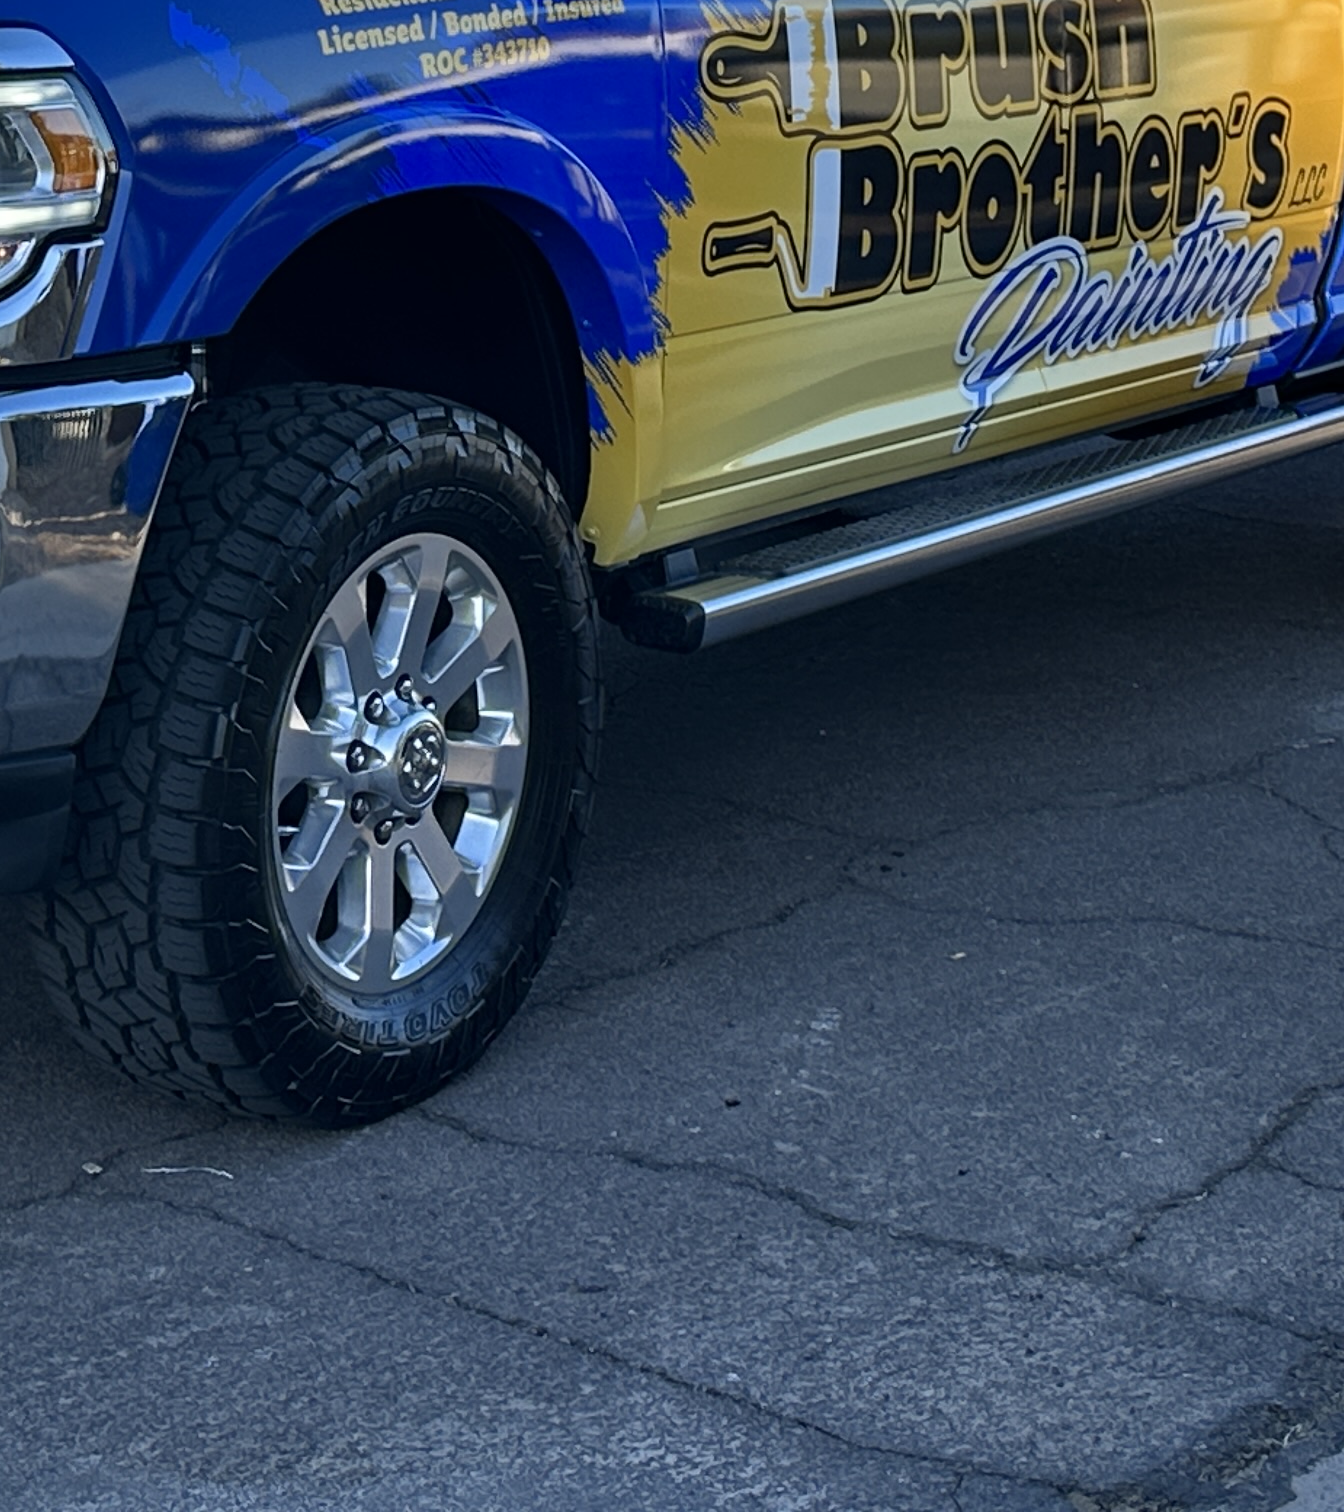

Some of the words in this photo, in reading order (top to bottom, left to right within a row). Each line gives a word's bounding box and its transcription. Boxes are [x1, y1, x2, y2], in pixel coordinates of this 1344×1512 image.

[317, 13, 425, 55] Licensed
[442, 0, 528, 36] Bonded
[420, 47, 468, 79] ROC
[834, 91, 1292, 300] Brother's
[1288, 163, 1328, 208] LLC
[953, 188, 1283, 454] Painting
